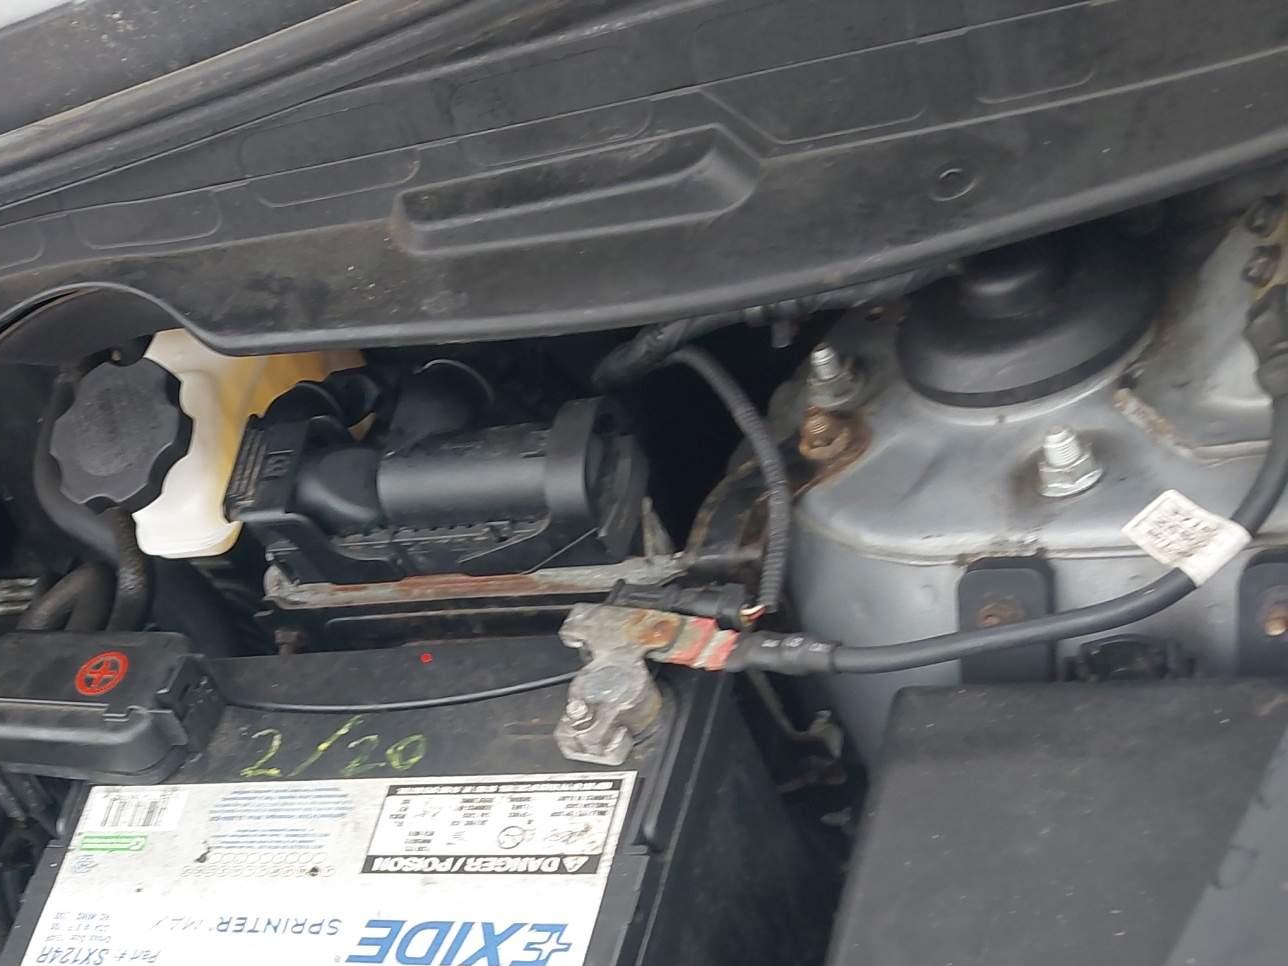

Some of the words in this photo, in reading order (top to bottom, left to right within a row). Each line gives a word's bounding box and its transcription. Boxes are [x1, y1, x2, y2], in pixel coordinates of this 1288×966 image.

[371, 857, 451, 872] POISON
[465, 857, 561, 873] DANGER
[216, 917, 344, 936] SPRINTER
